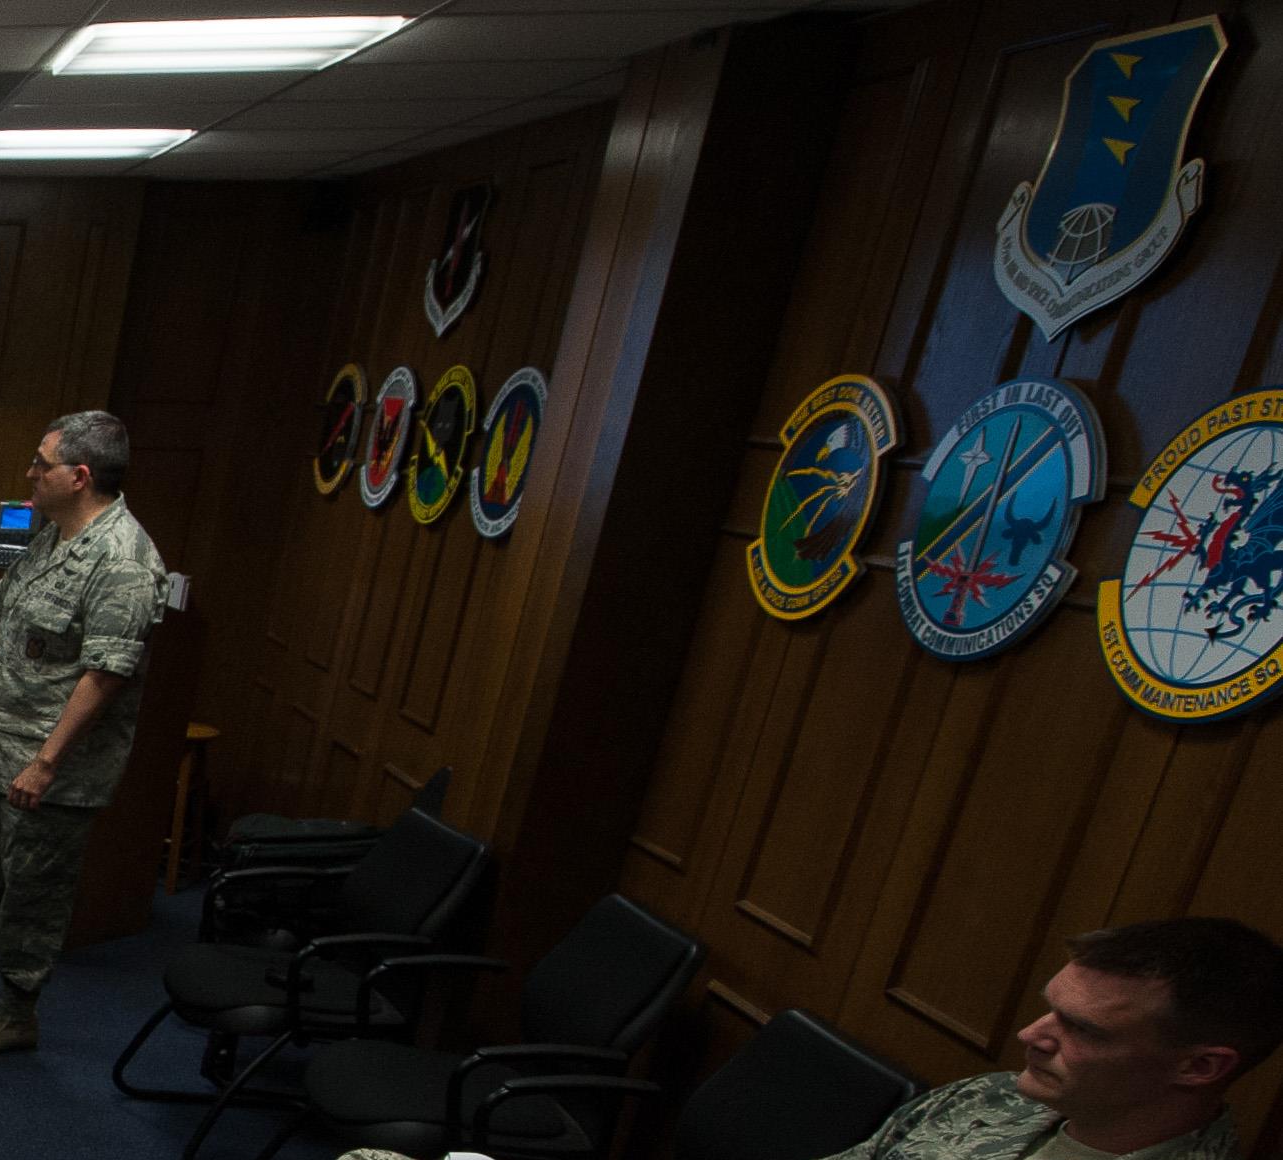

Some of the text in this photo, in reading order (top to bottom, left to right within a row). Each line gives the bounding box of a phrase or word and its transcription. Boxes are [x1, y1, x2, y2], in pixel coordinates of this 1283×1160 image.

[959, 384, 1083, 442] FIRST IN LAST OUT
[1143, 428, 1201, 490] PROUD
[1207, 400, 1257, 434] PAST
[898, 576, 924, 632] COMBAT
[921, 599, 1034, 655] COMMUNICATIONS
[1035, 573, 1055, 600] SQ
[1103, 620, 1280, 713] 1ST COMM MAINTENANCE SQ
